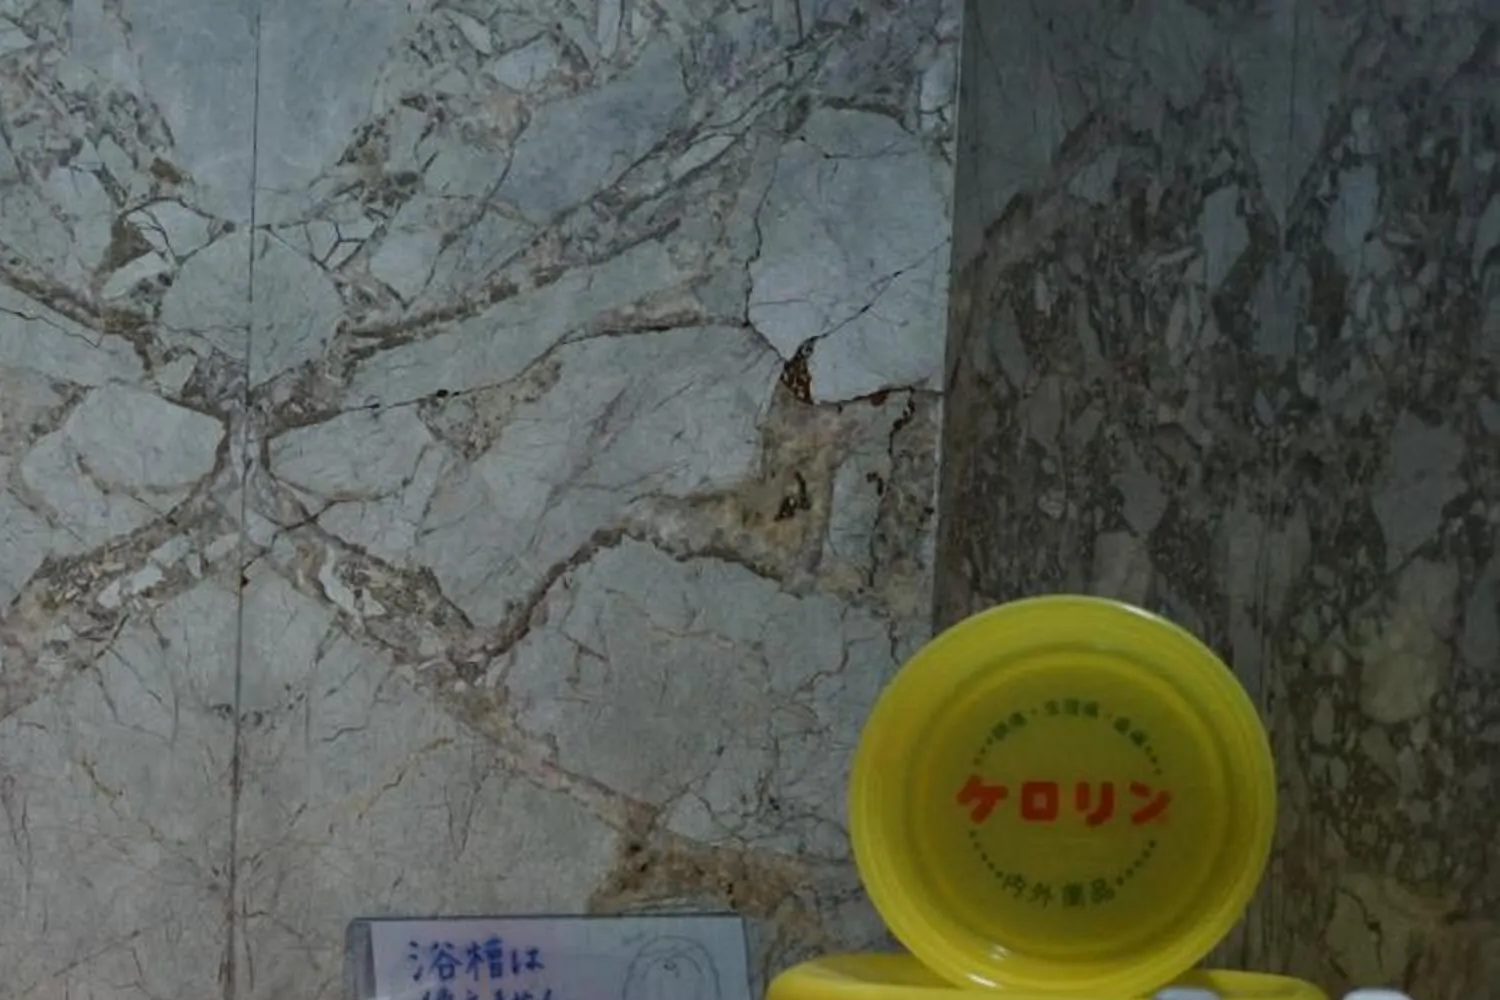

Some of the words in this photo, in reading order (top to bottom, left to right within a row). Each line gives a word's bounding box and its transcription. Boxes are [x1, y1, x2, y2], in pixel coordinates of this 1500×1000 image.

[956, 774, 1173, 828] ケロリン
[408, 934, 545, 982] 浴槽は
